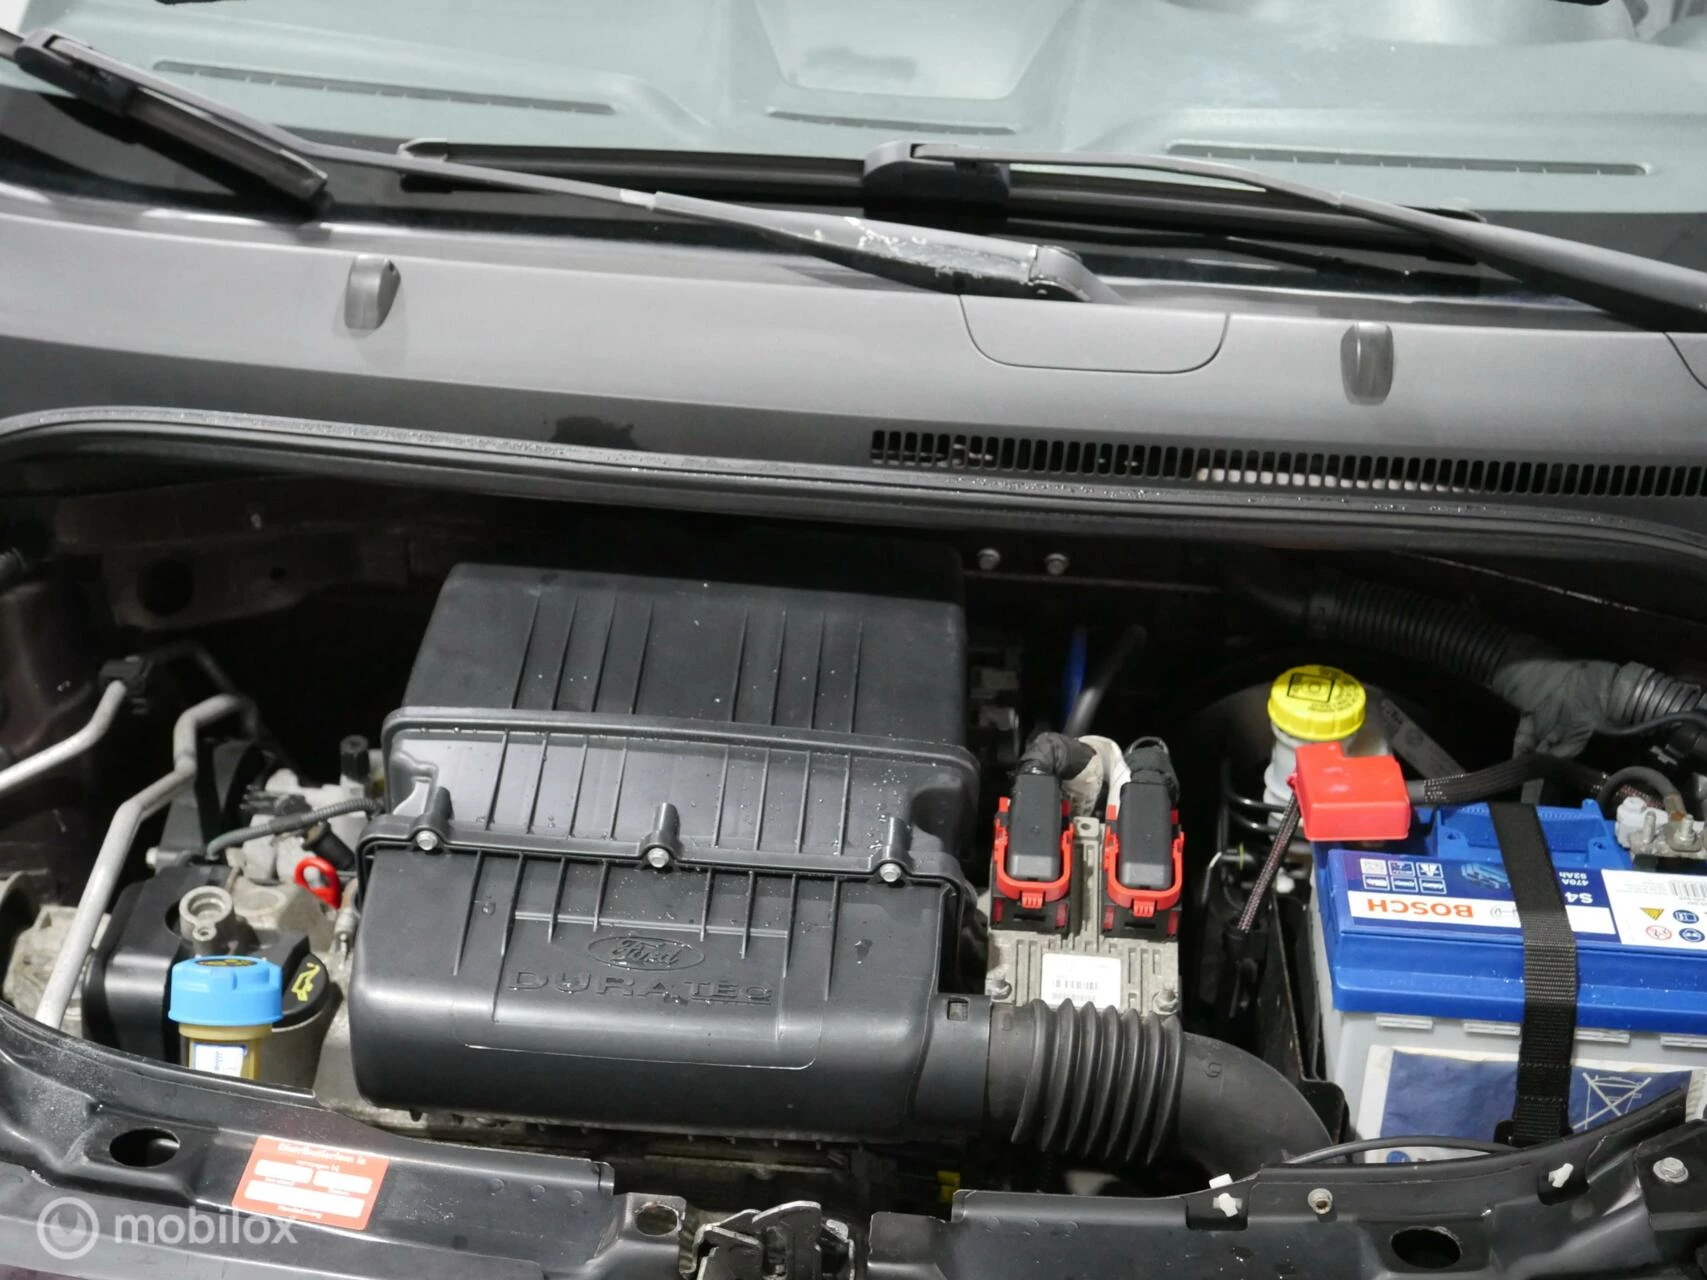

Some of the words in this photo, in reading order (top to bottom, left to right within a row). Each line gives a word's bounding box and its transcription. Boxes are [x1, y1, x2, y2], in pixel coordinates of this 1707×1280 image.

[1367, 898, 1474, 918] BOSCH
[1565, 891, 1593, 904] S4
[611, 939, 683, 965] Ford
[508, 970, 772, 1002] DURATEC
